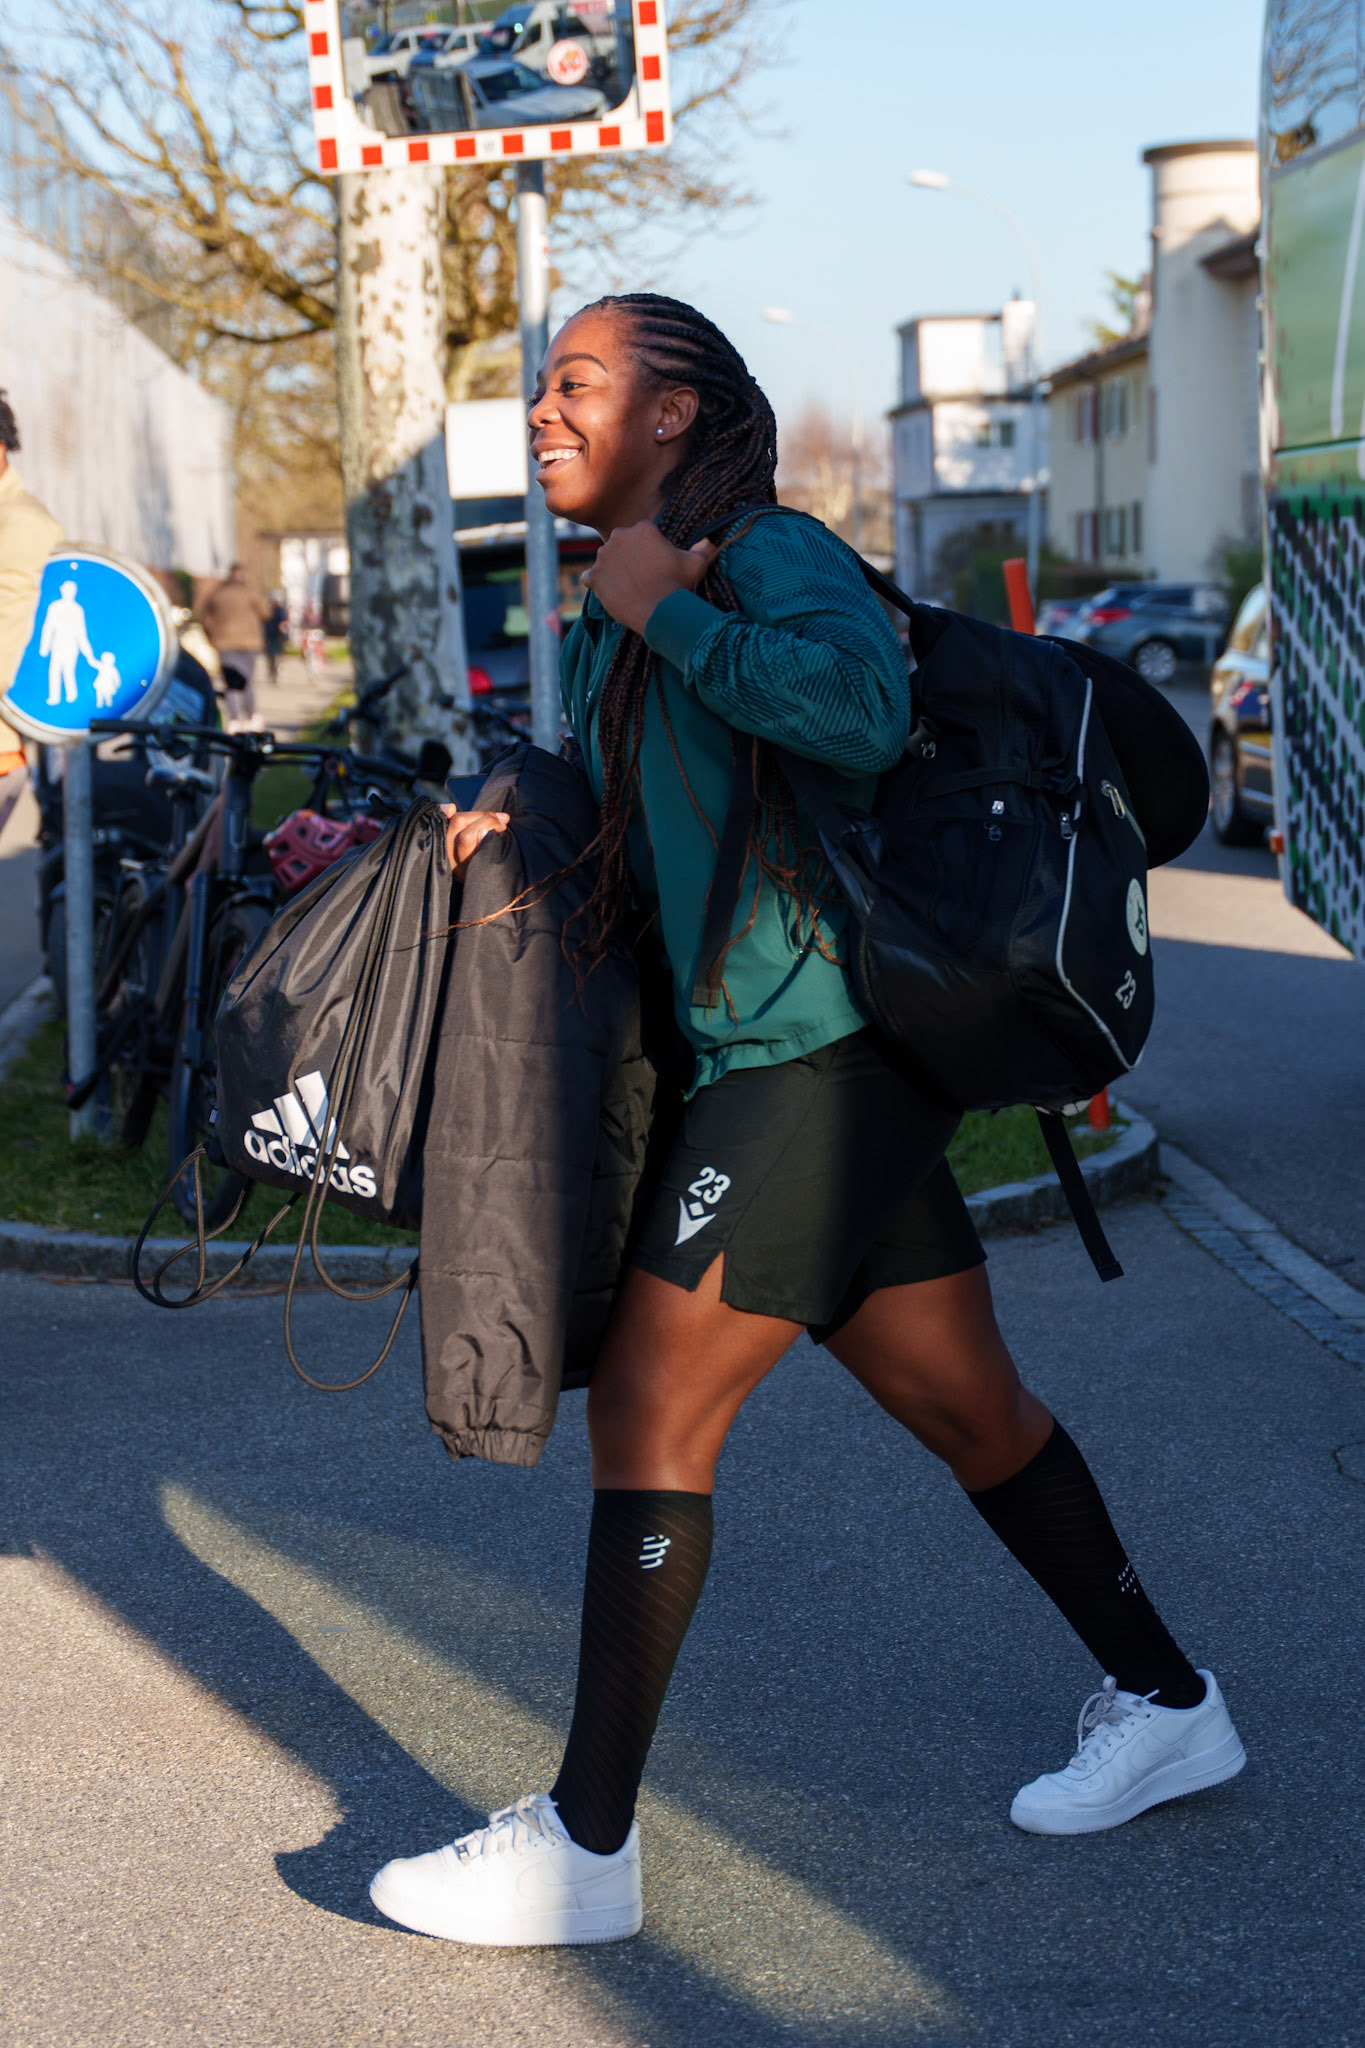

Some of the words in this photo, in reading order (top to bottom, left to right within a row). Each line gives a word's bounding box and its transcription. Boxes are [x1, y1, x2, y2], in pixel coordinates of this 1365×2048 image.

[1115, 969, 1137, 1010] 23
[243, 1129, 377, 1198] adidas
[687, 1166, 731, 1205] 23
